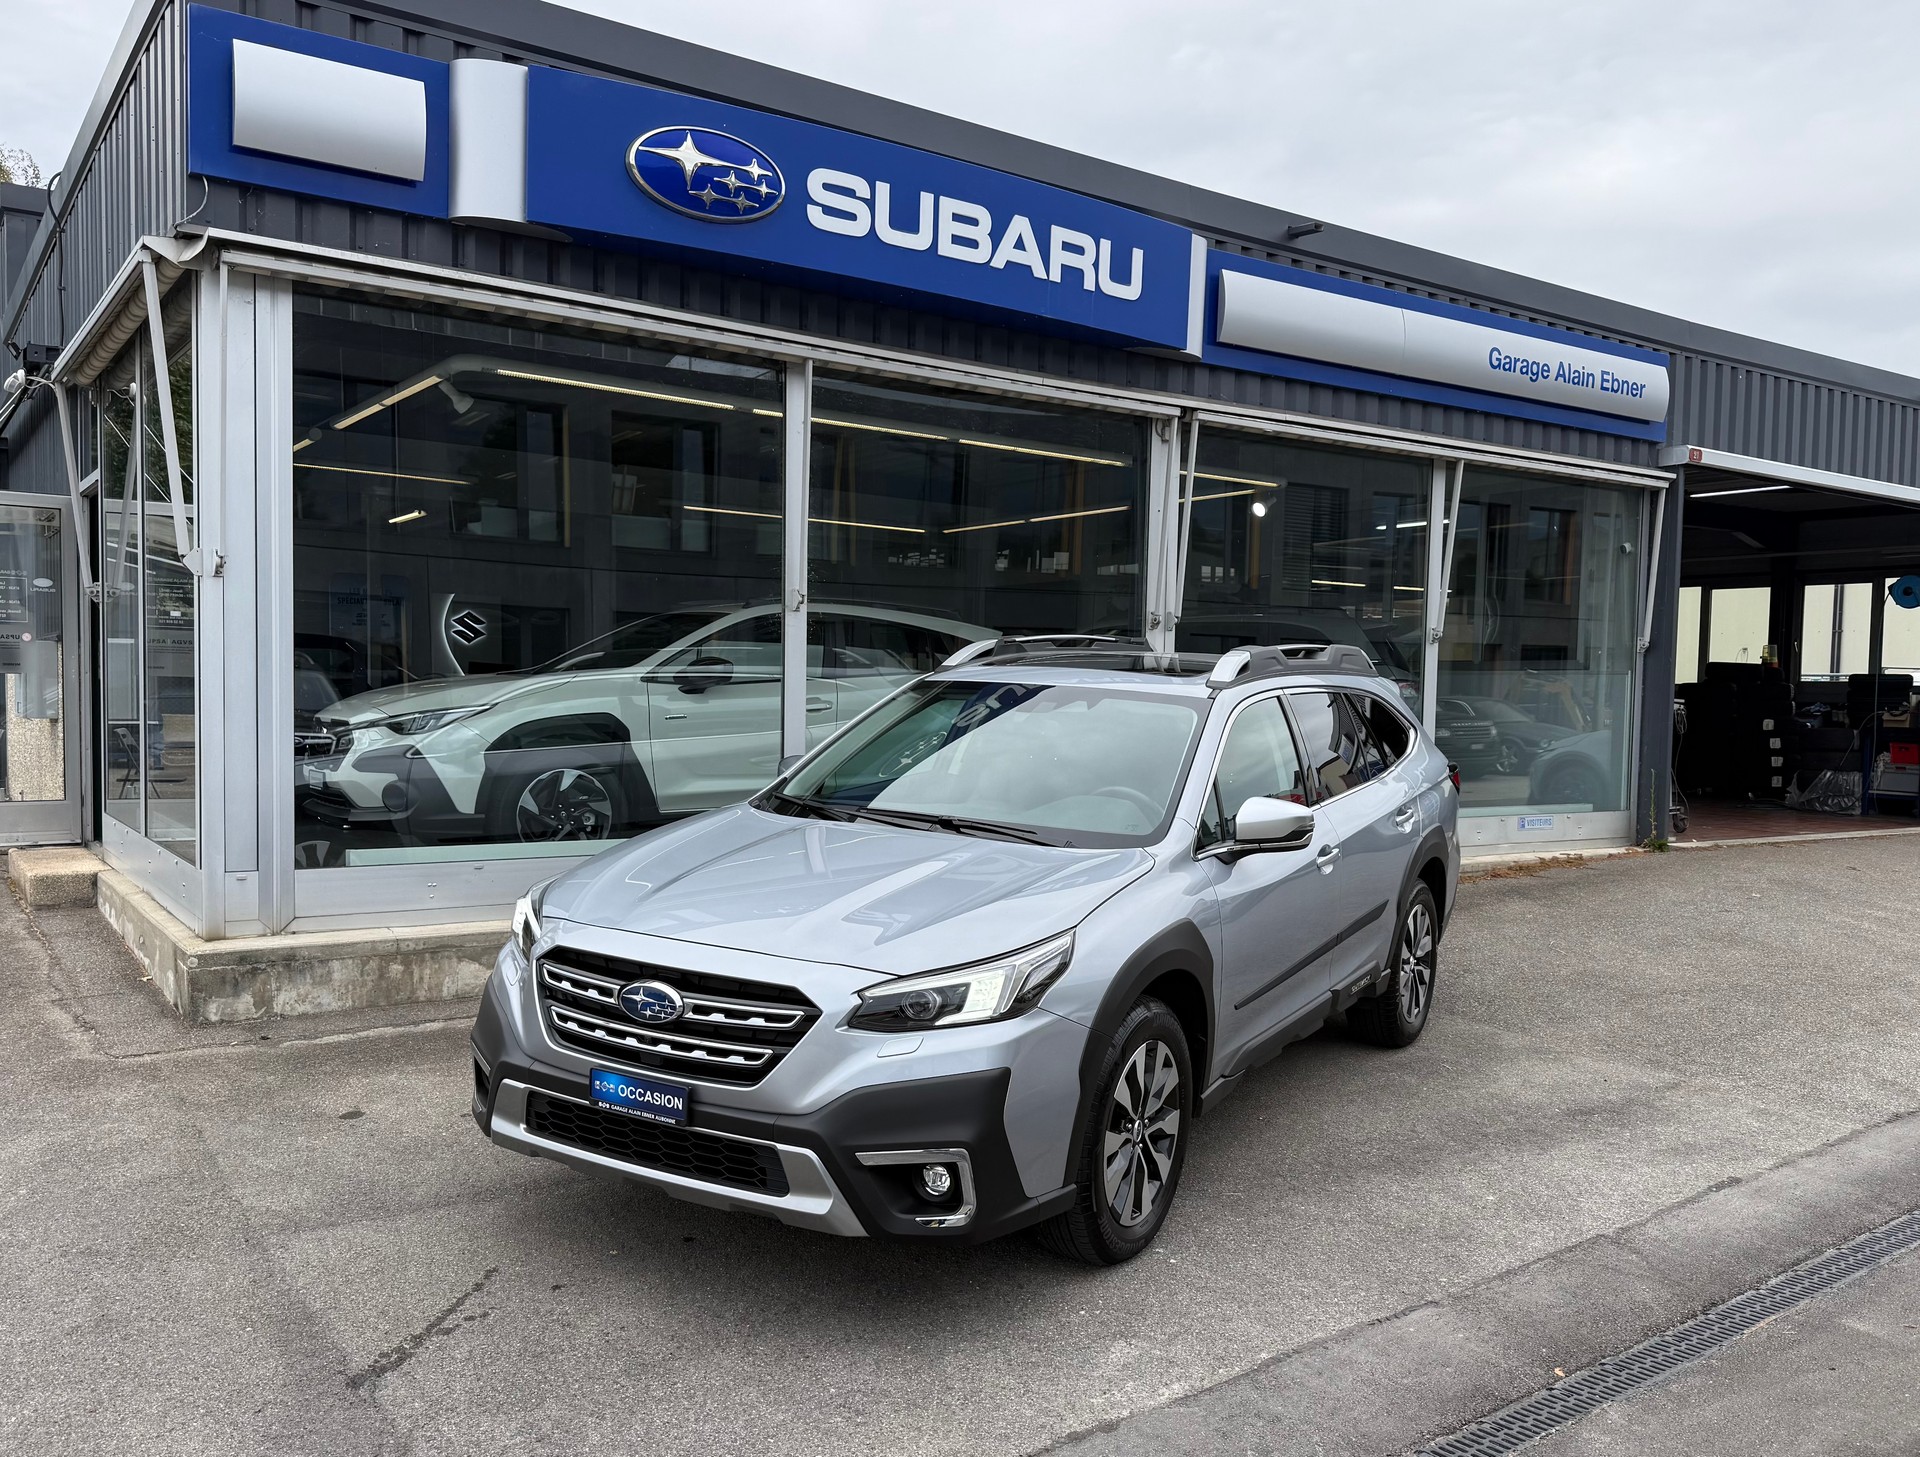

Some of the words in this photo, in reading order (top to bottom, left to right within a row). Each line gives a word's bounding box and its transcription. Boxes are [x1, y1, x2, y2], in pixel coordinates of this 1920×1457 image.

[806, 167, 1144, 301] SUBARU
[1488, 346, 1551, 382] Garage
[1554, 361, 1595, 389] Alain
[1600, 370, 1646, 399] Ebner
[1527, 818, 1552, 827] VISITEURS
[611, 1104, 628, 1113] GARAGE
[629, 1108, 641, 1116] ALAIN
[618, 1085, 683, 1110] OCCASION
